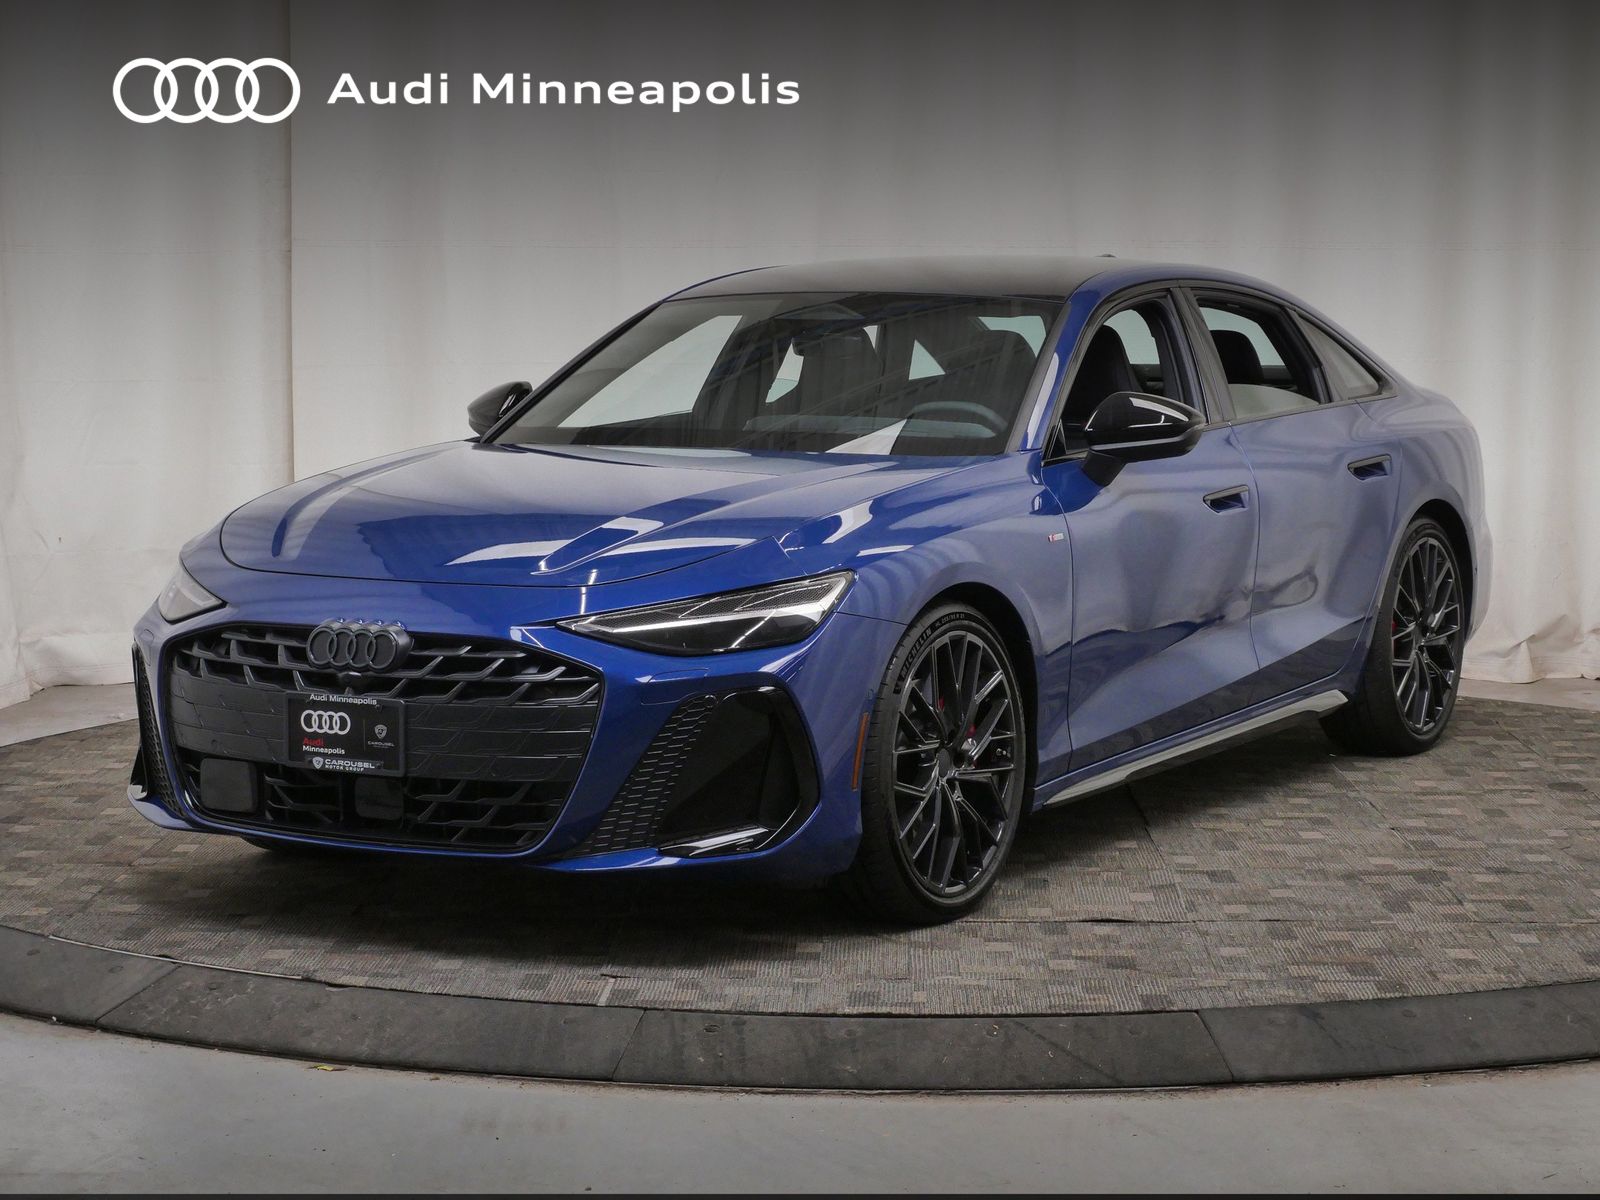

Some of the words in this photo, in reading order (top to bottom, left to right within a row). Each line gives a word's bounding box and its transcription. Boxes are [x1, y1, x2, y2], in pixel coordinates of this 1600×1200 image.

[901, 627, 932, 678] MICHELIN
[309, 693, 328, 702] Audi
[329, 694, 377, 706] Minneapolis
[303, 738, 324, 747] Audi
[302, 745, 346, 755] Minneapolis
[324, 758, 375, 769] CAROUSEL
